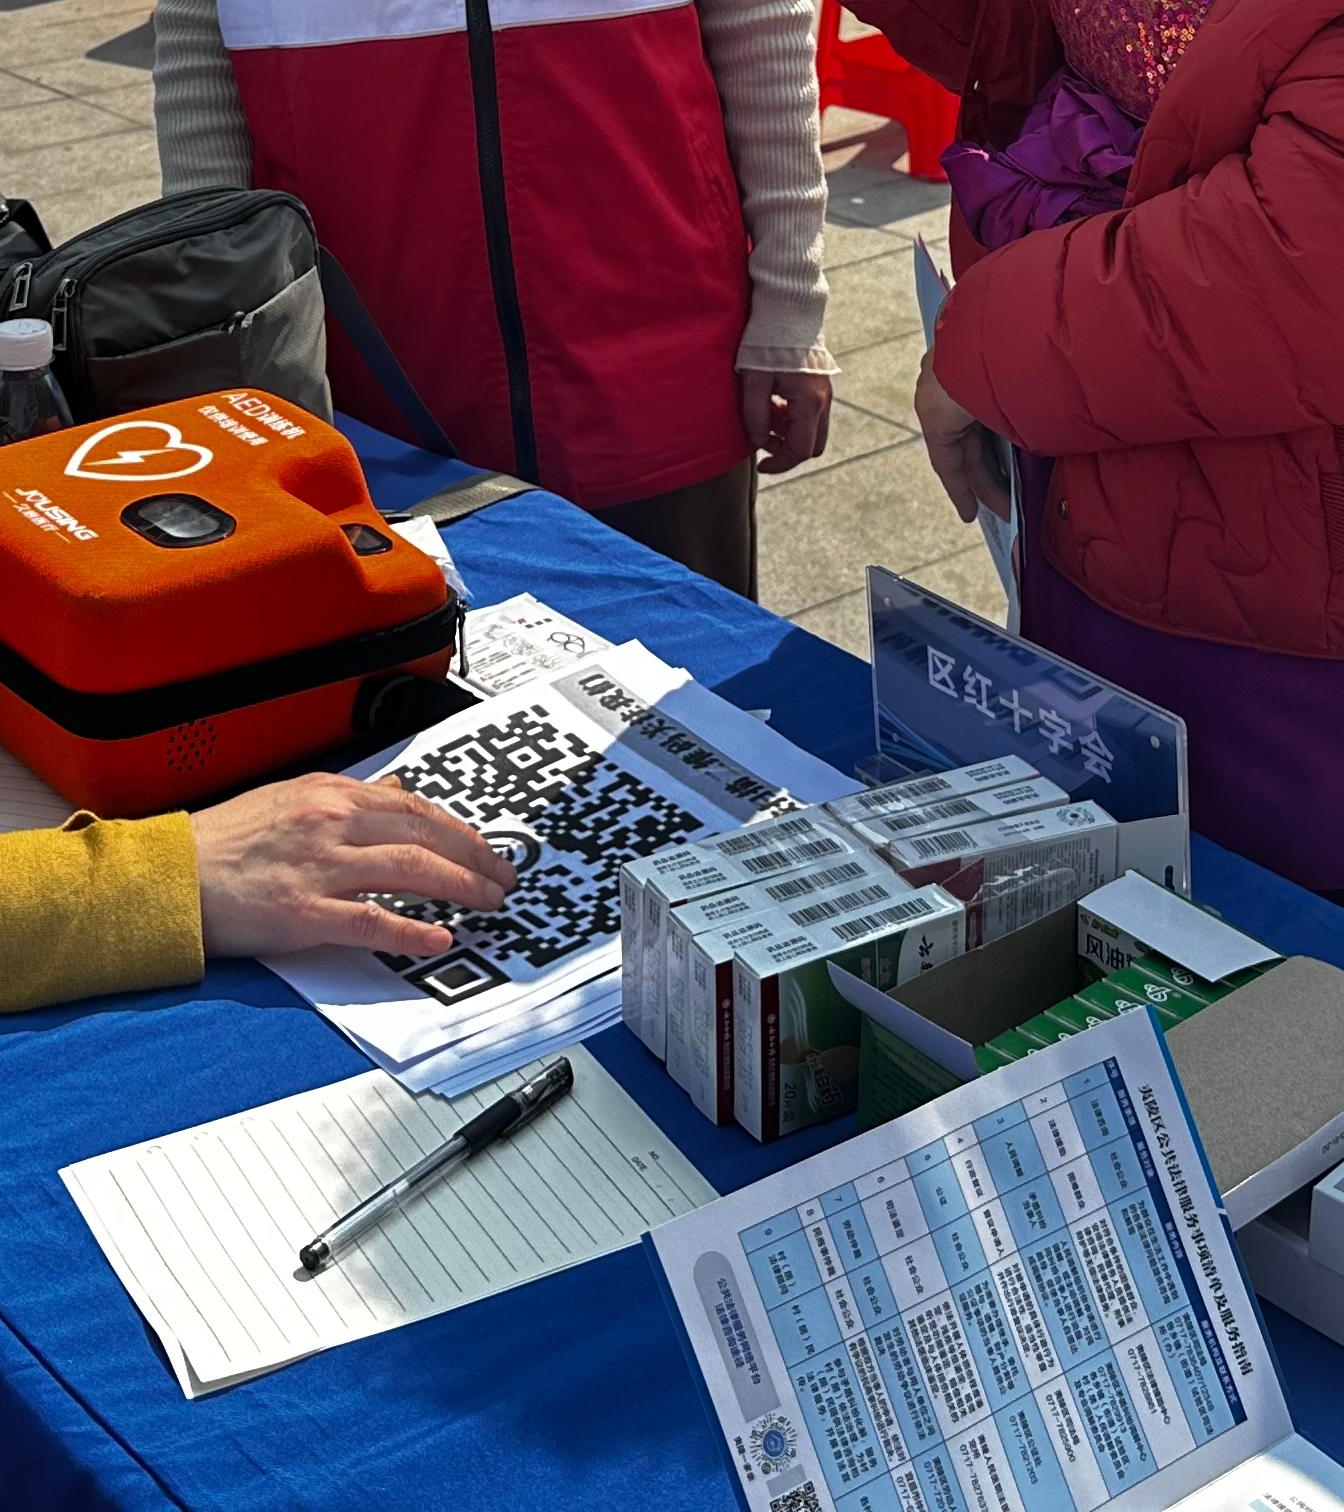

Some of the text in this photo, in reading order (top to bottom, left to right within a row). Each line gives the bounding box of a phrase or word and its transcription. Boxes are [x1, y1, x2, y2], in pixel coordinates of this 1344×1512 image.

[220, 390, 306, 442] AED训练机
[14, 487, 100, 542] JOUSING
[926, 643, 1117, 784] 区红十字会
[1083, 932, 1137, 974] 风油
[1136, 1083, 1254, 1376] 夷陵区公共法律服务事项清单及服务指南
